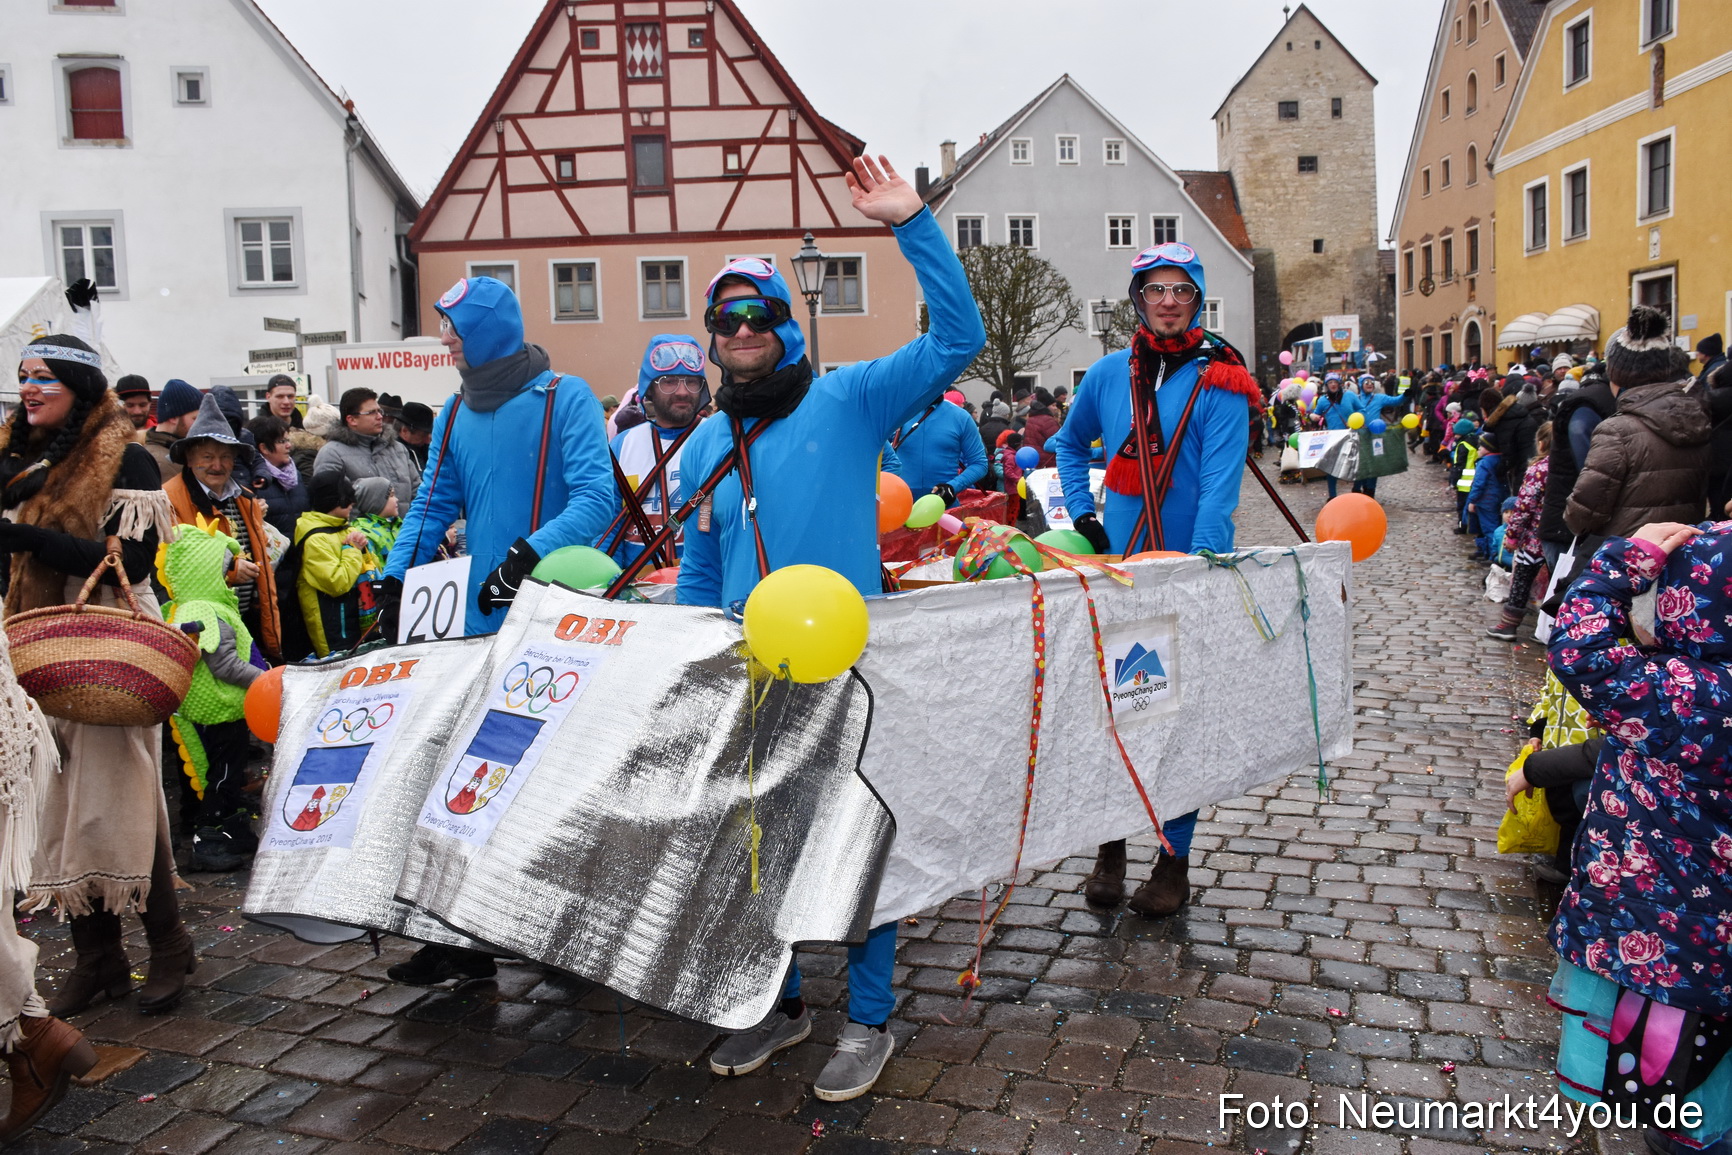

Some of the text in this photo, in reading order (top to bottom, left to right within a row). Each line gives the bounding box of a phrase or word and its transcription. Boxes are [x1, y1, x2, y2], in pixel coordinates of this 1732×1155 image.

[304, 333, 343, 344] Probststraße
[251, 362, 273, 370] Fußweg
[406, 580, 458, 644] 20
[554, 613, 638, 646] OBI
[552, 654, 565, 663] bei
[564, 656, 590, 668] Olympia
[339, 659, 420, 690] OBI
[373, 692, 400, 702] Olympia
[1113, 681, 1168, 702] PyeongChang 2018
[423, 812, 477, 837] PyeongChang 2018
[269, 833, 333, 847] PyeongChang 2018
